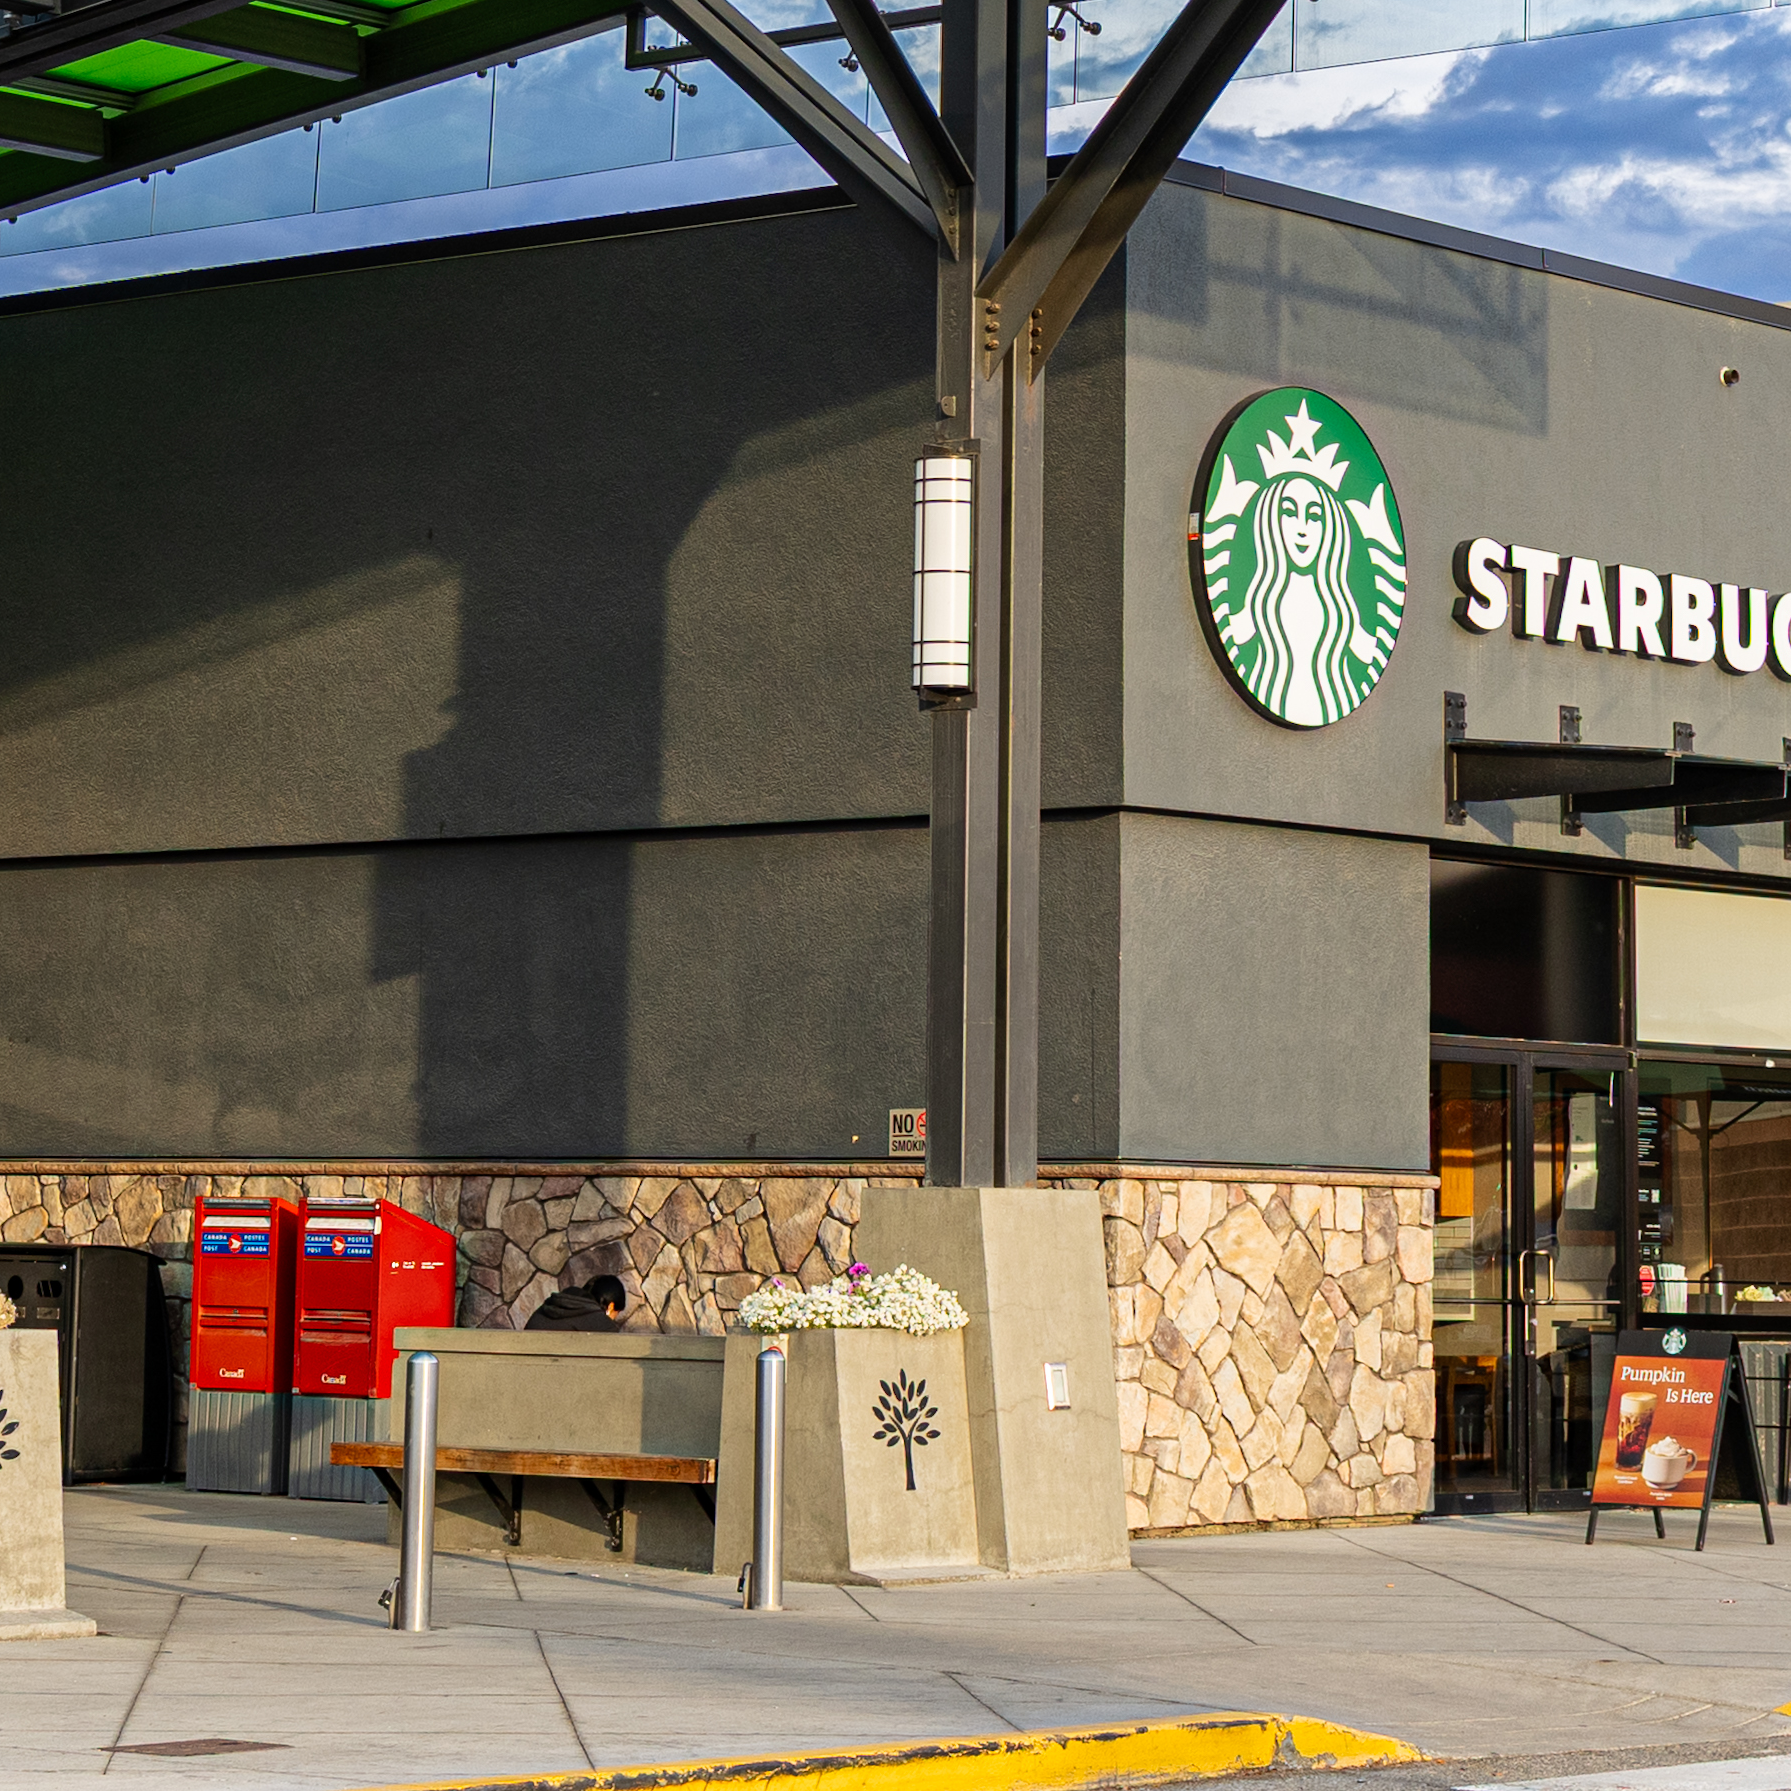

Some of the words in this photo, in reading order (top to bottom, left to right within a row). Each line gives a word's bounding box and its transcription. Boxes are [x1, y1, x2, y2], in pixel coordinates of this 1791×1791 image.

[892, 1113, 914, 1134] NO
[891, 1139, 926, 1152] SMOKIN
[1620, 1365, 1686, 1385] Pumpkin
[1665, 1387, 1679, 1403] Is
[1680, 1388, 1714, 1404] Here
